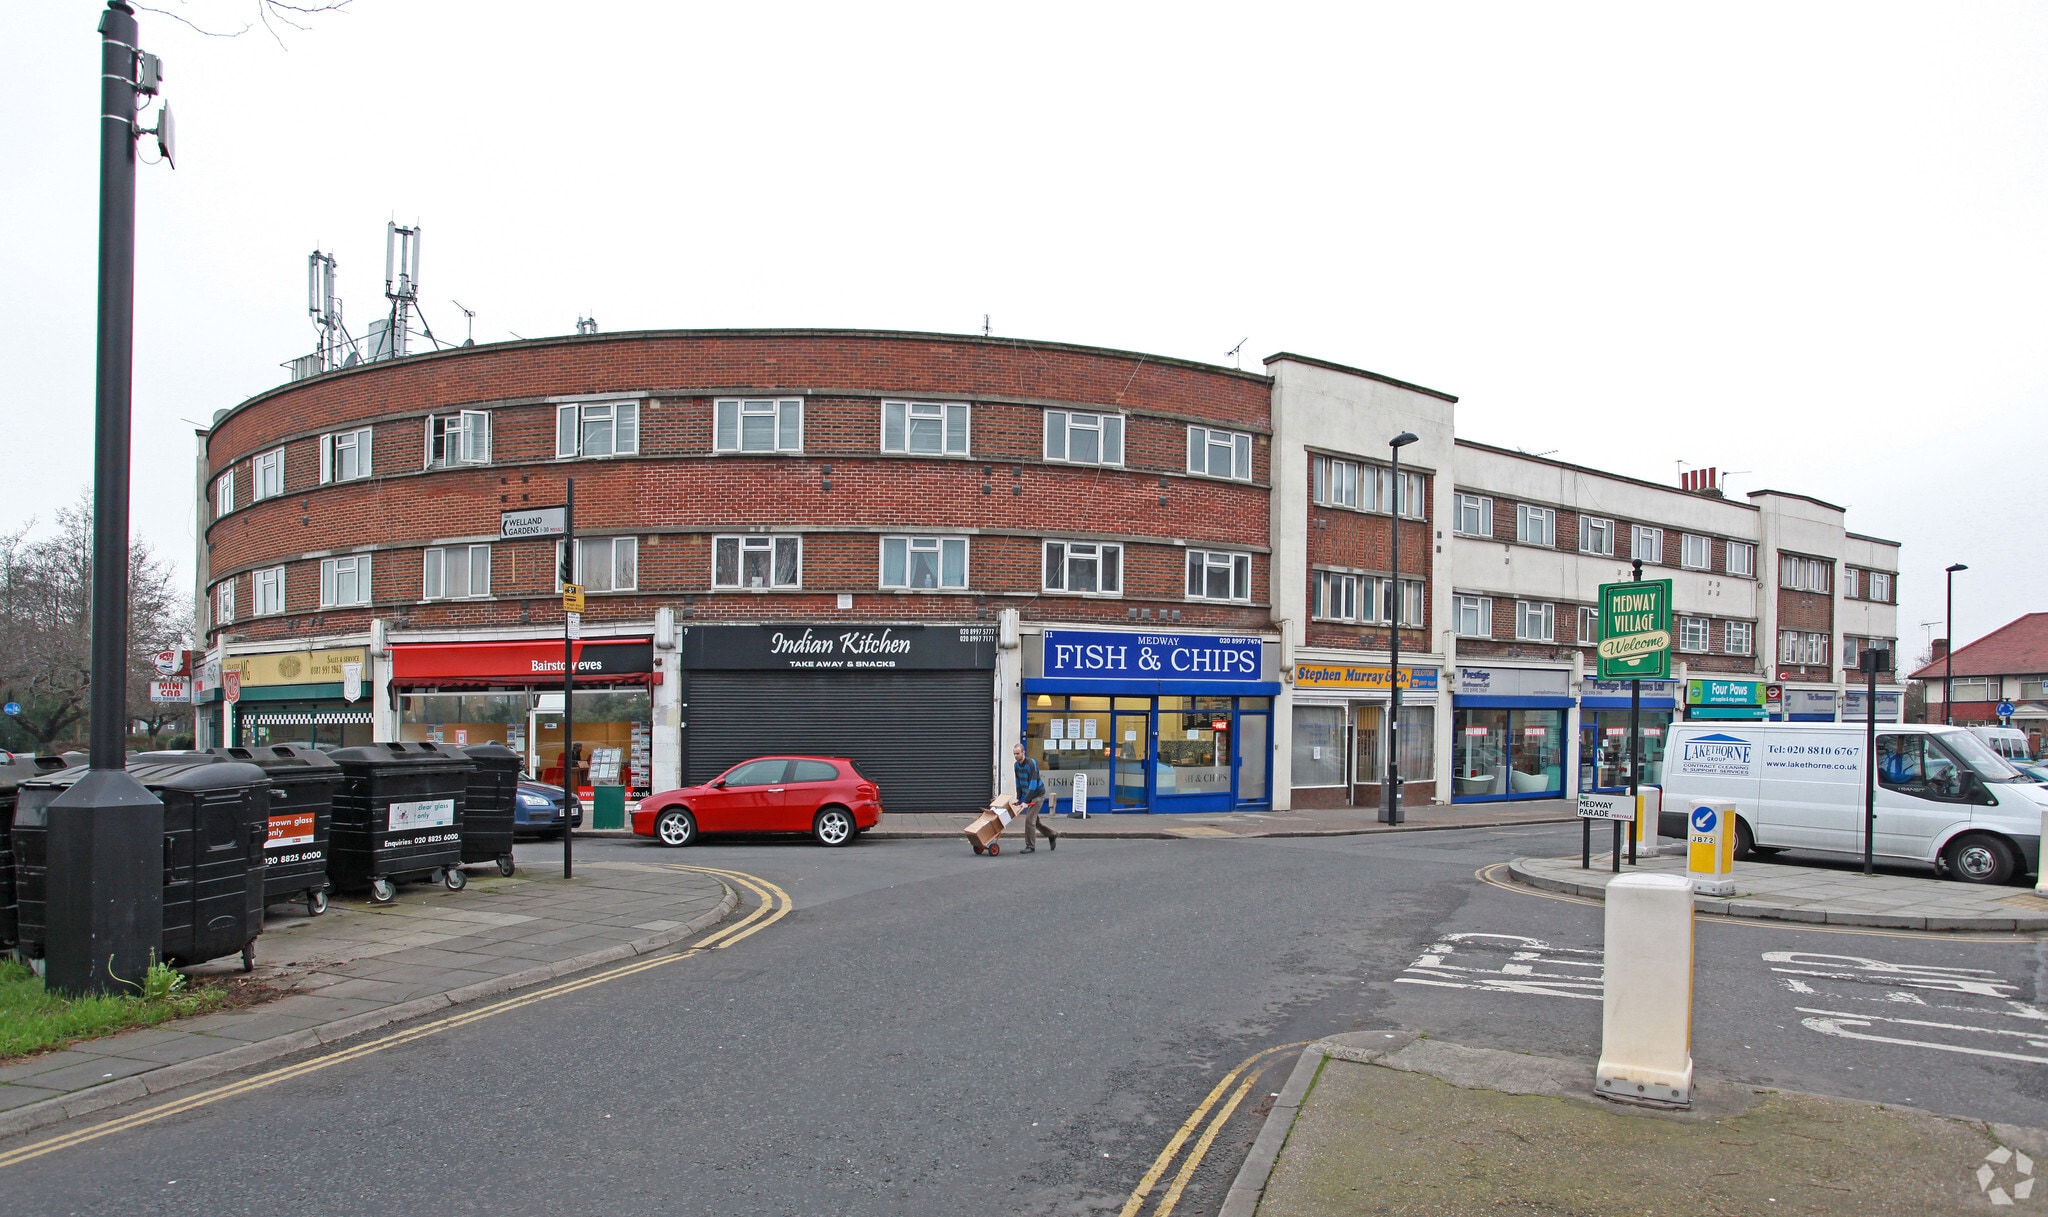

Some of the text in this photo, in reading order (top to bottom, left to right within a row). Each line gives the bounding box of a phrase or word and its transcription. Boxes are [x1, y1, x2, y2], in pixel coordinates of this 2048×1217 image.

[509, 517, 542, 527] WELLAND
[508, 527, 539, 536] GARDENS
[1613, 593, 1656, 613] MEDWAY
[1614, 614, 1654, 632] VILLAGE
[771, 628, 910, 654] Indian Kitchen
[1137, 636, 1179, 646] MEDWAY
[1247, 638, 1261, 646] 7474
[1603, 637, 1664, 655] Welcome
[1055, 644, 1256, 674] FISH & CHIPS
[1297, 667, 1340, 683] Stephen
[1345, 669, 1383, 684] Murray
[1462, 669, 1490, 681] Prestige
[1712, 683, 1728, 695] Four
[1730, 683, 1748, 696] Paws
[1683, 744, 1751, 764] LAKETHORNE
[1768, 745, 1859, 756] Tel: 020 8810 6767
[1766, 760, 1857, 770] www.lakethorne.co.uk
[1048, 778, 1067, 787] FISH
[1086, 777, 1105, 786] HIPS
[434, 802, 449, 811] glass
[1579, 801, 1613, 809] MEDWAY
[417, 812, 430, 820] only
[1579, 809, 1609, 818] PARADE
[294, 816, 313, 827] glass
[384, 832, 459, 848] Enquiries: 020 8825 6000
[1692, 836, 1714, 844] JB72
[280, 853, 300, 864] 8825
[302, 850, 322, 861] 6000
